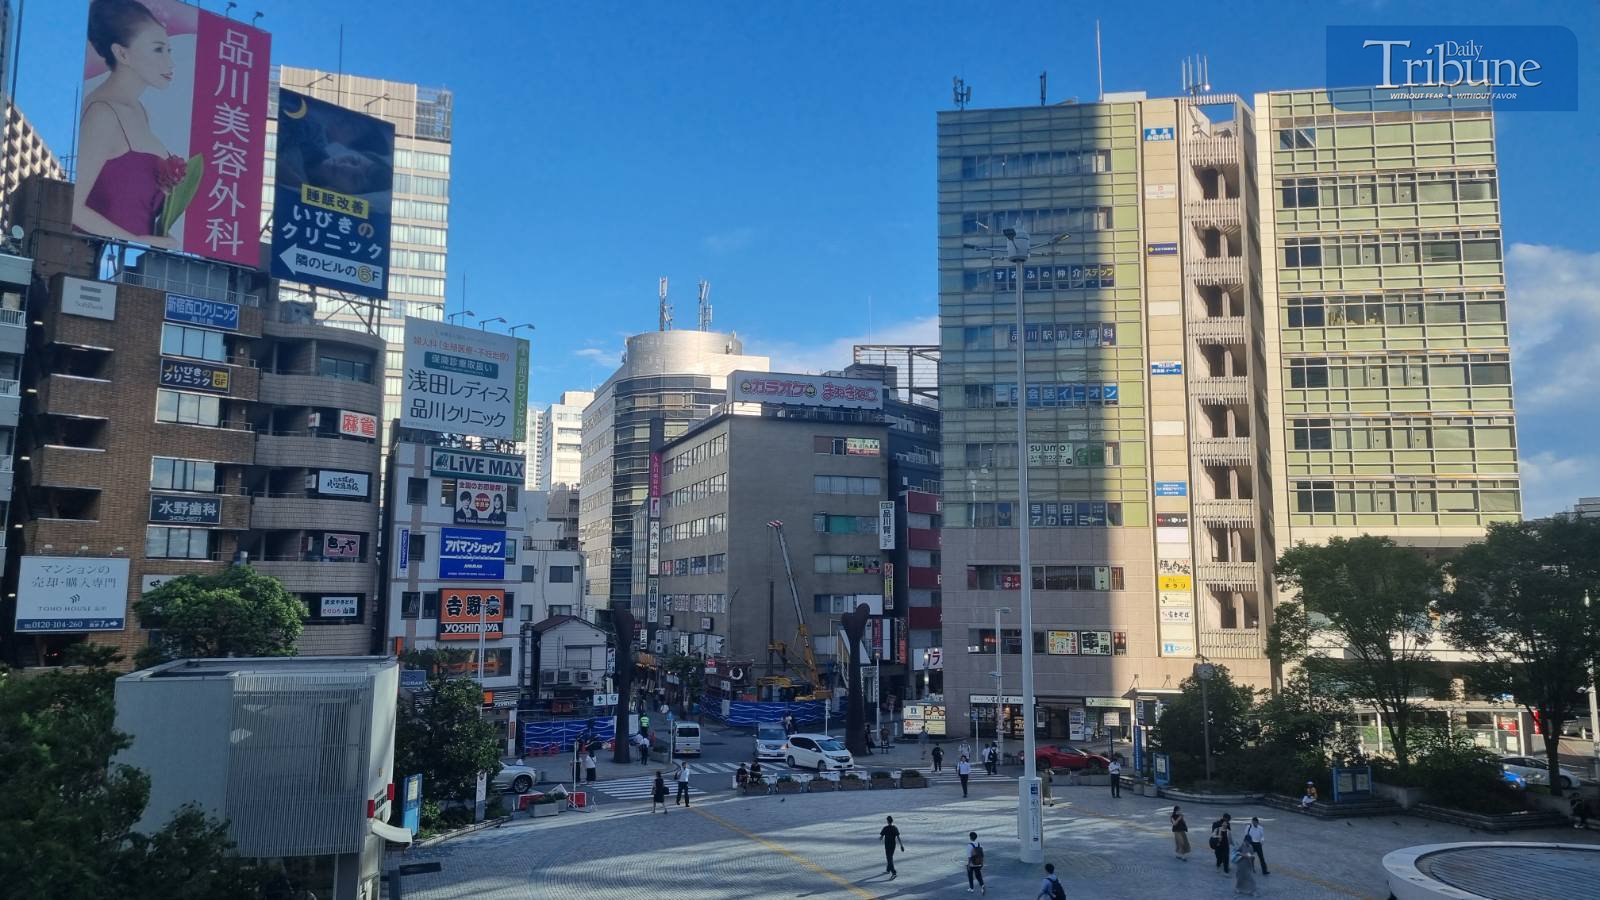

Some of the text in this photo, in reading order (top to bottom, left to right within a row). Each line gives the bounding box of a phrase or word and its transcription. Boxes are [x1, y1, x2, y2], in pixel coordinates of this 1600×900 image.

[205, 28, 253, 256] 品川美容外科
[307, 188, 364, 214] 睡眠改善
[293, 204, 375, 239] いびきの
[282, 222, 383, 260] クリニック
[296, 253, 380, 283] 隣のビルの6F
[167, 296, 238, 321] 新宿西口クリニック
[164, 372, 210, 386] クリニック
[174, 365, 211, 378] いびきの
[408, 368, 511, 403] 浅田レディース
[751, 378, 806, 398] カラオケ
[822, 382, 878, 401] まねきねこ
[410, 398, 506, 428] 品川クリニック
[344, 414, 375, 437] 麻雀
[489, 460, 523, 477] MAX
[158, 501, 217, 517] 水野歯科
[445, 540, 501, 554] アパマンショップ
[41, 565, 110, 575] マンションの
[33, 576, 116, 588] 売却・購入専門
[446, 595, 501, 617] 吉野家
